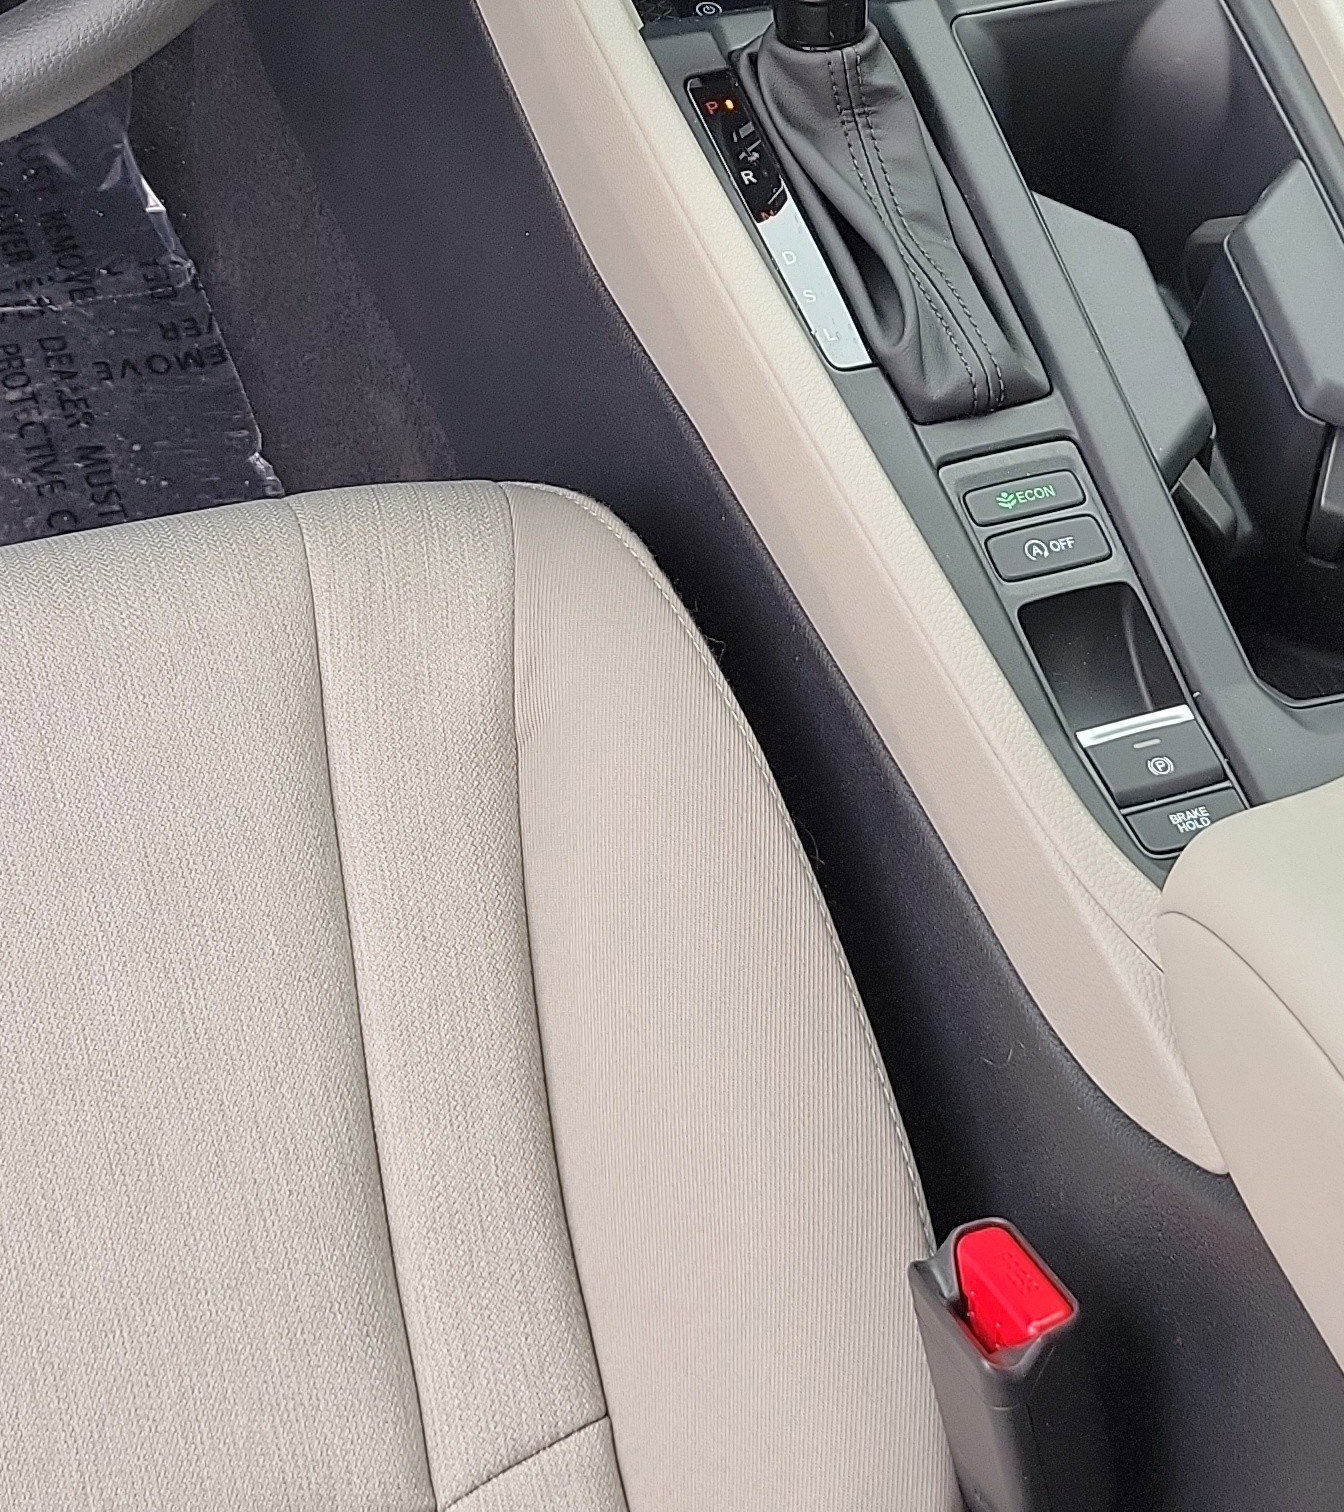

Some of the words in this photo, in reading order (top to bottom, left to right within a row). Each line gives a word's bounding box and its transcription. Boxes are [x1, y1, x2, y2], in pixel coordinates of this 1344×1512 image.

[705, 101, 719, 114] P
[740, 169, 757, 185] R
[782, 251, 797, 265] D
[803, 289, 817, 303] S
[823, 328, 838, 342] L
[76, 445, 129, 518] MUST
[1015, 485, 1055, 504] ECON
[1049, 536, 1075, 553] OFF
[1169, 806, 1210, 826] BRAKE
[1177, 817, 1211, 834] HOLD
